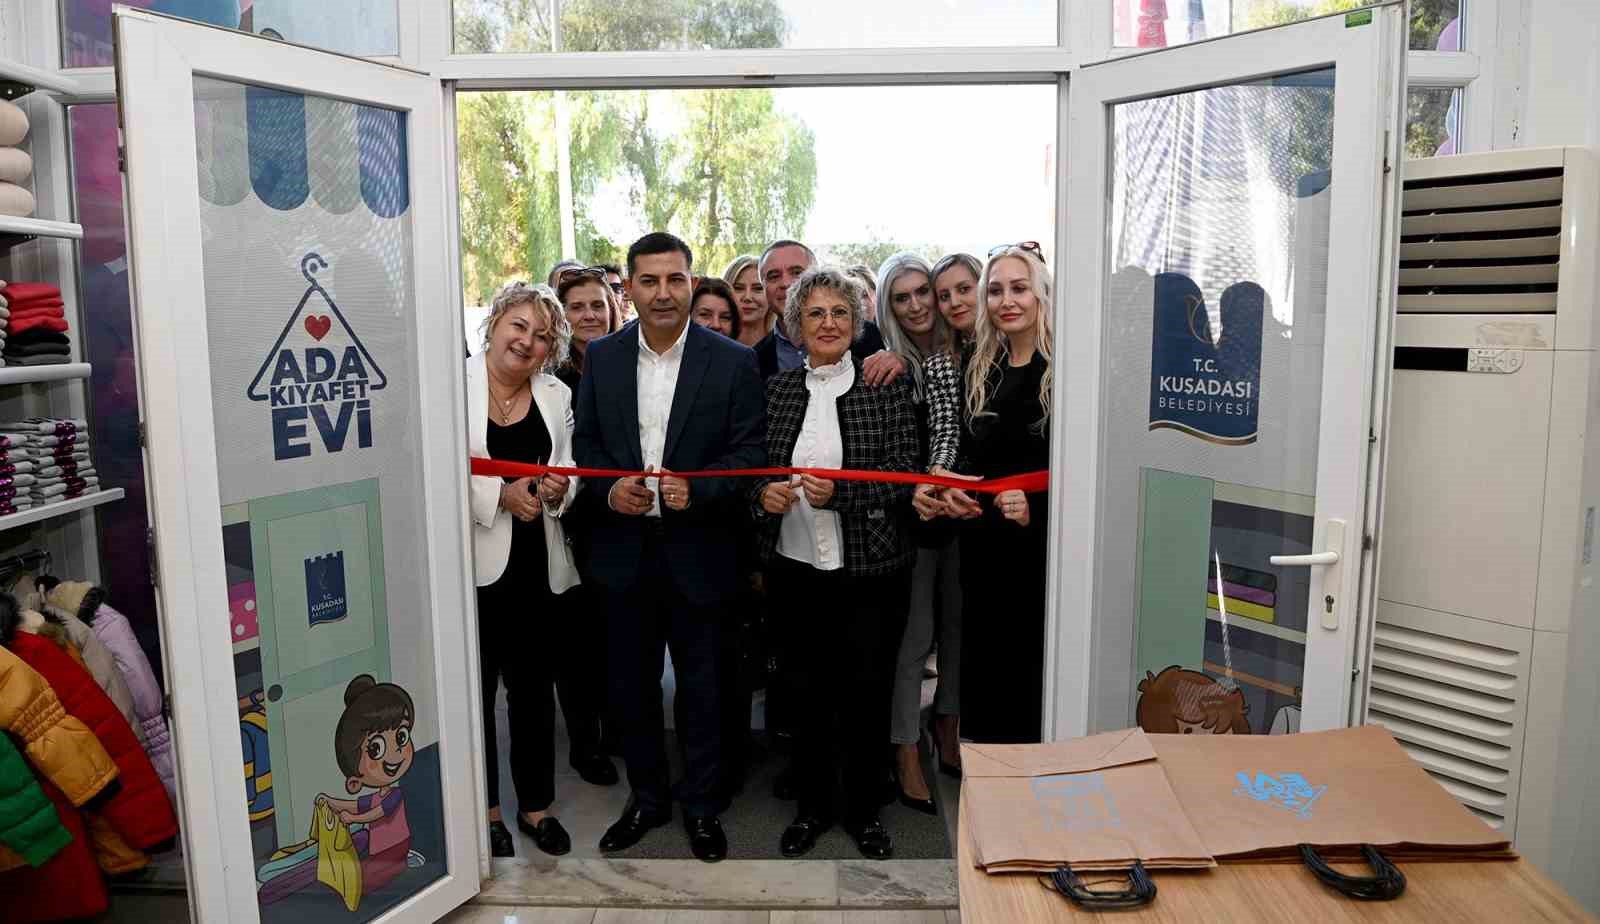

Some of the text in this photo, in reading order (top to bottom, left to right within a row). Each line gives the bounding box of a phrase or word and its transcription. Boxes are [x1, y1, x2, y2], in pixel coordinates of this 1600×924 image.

[270, 346, 368, 385] ADA
[1192, 358, 1218, 373] T.C.
[270, 380, 369, 407] KIYAFET
[1159, 376, 1251, 399] KUŞADASI
[1159, 397, 1249, 416] BELEDİYESİ
